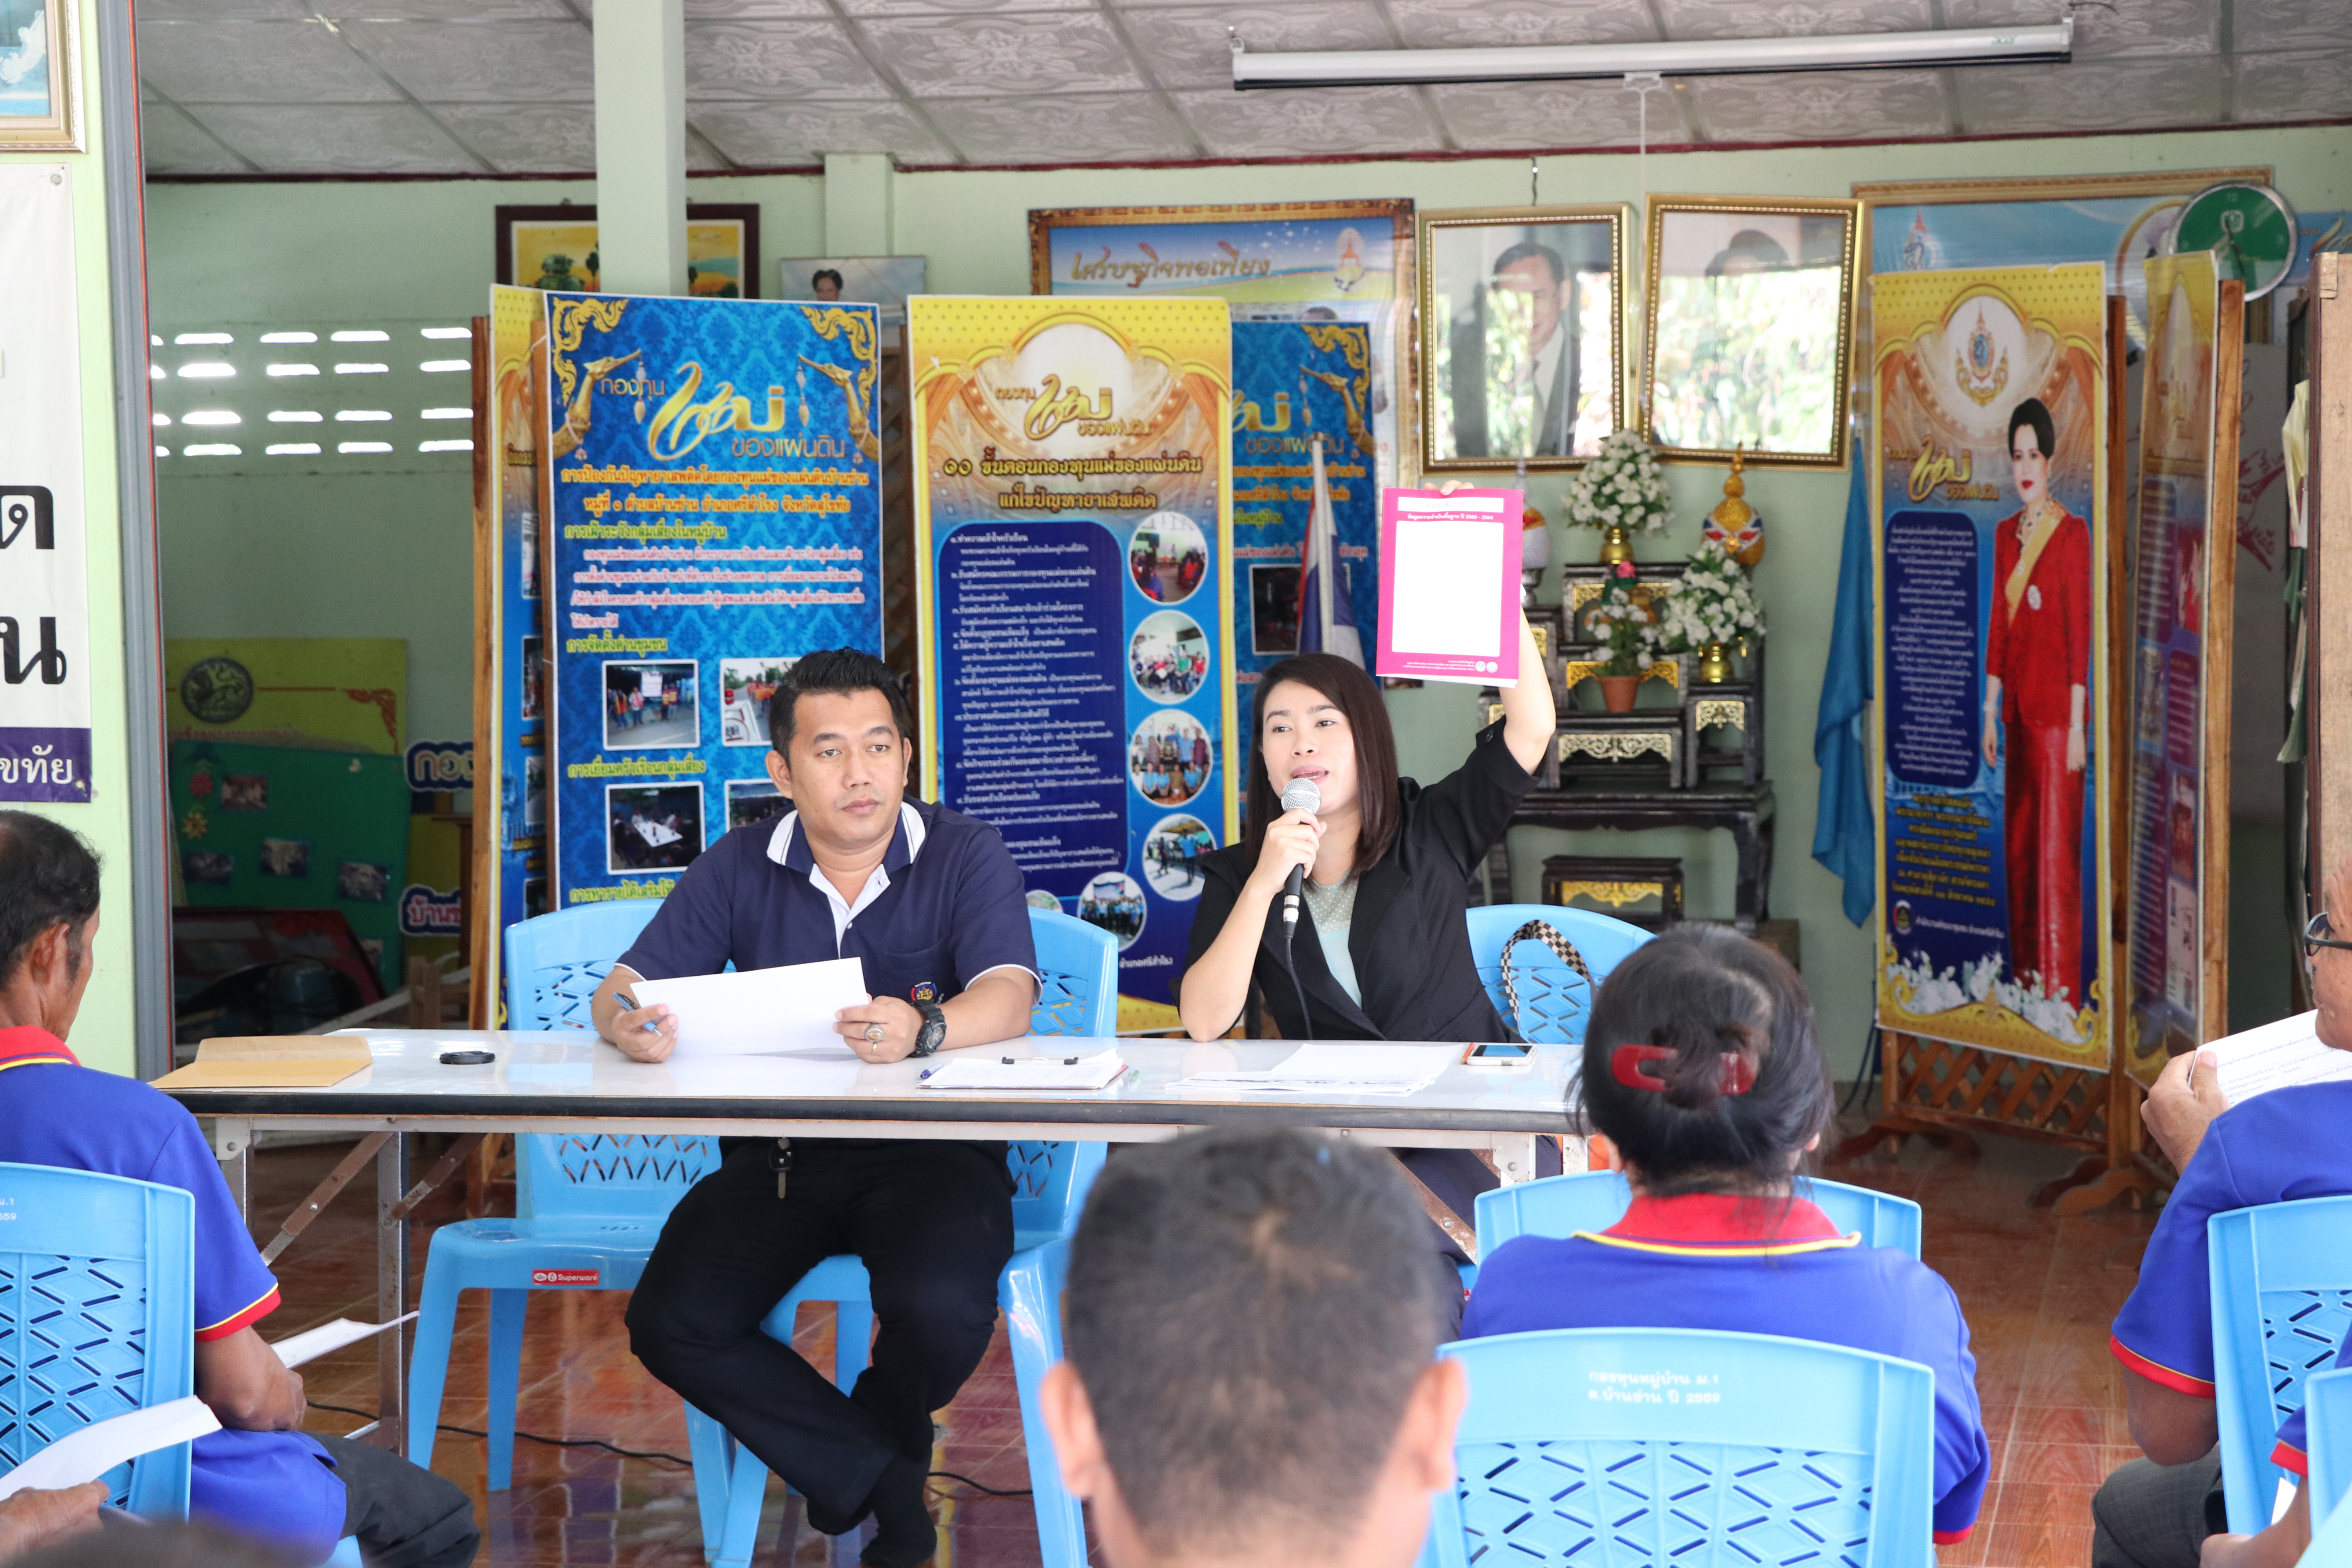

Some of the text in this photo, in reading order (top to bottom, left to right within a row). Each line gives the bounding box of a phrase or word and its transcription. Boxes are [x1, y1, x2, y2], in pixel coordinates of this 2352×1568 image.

[1072, 241, 1271, 287] เศรษฐกิจพอเพียง
[600, 378, 665, 401] กองทุน
[732, 433, 845, 458] ของแผ่นดิน
[1589, 1370, 1691, 1389] กองทุนหมู่บ้าน
[1686, 1392, 1721, 1403] 2559
